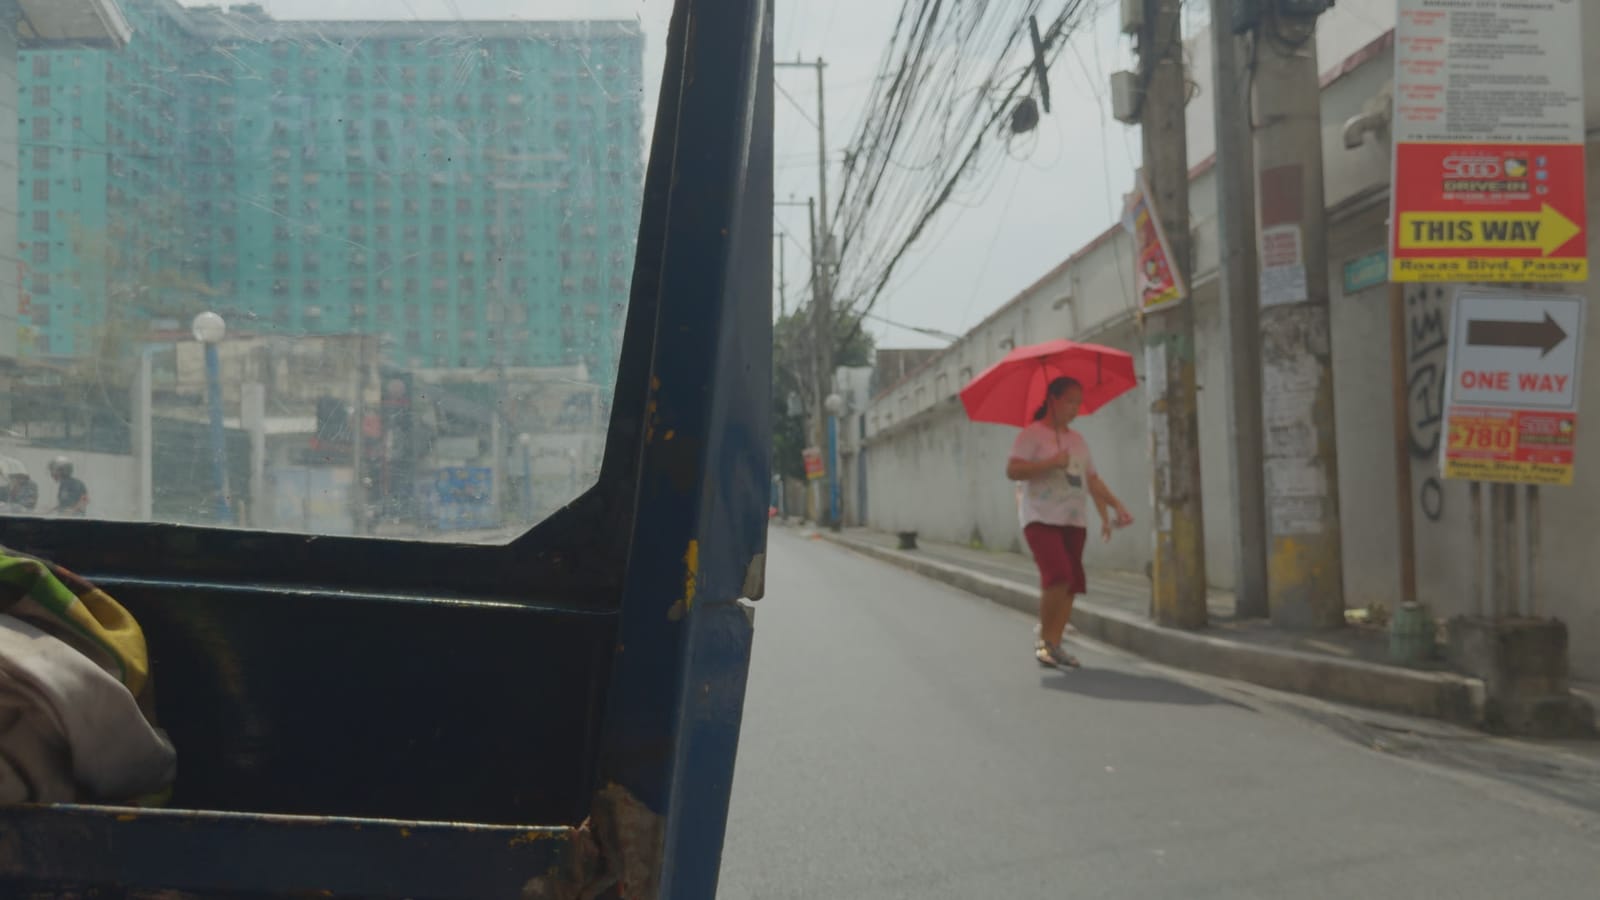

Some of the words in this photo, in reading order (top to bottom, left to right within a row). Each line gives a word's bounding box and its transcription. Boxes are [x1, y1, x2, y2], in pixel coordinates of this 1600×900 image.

[1411, 219, 1473, 242] THIS
[1480, 219, 1541, 242] WAY
[1400, 259, 1460, 271] Roxas
[1522, 259, 1582, 273] Pasay
[1460, 370, 1511, 391] ONE
[1517, 373, 1570, 394] WAY
